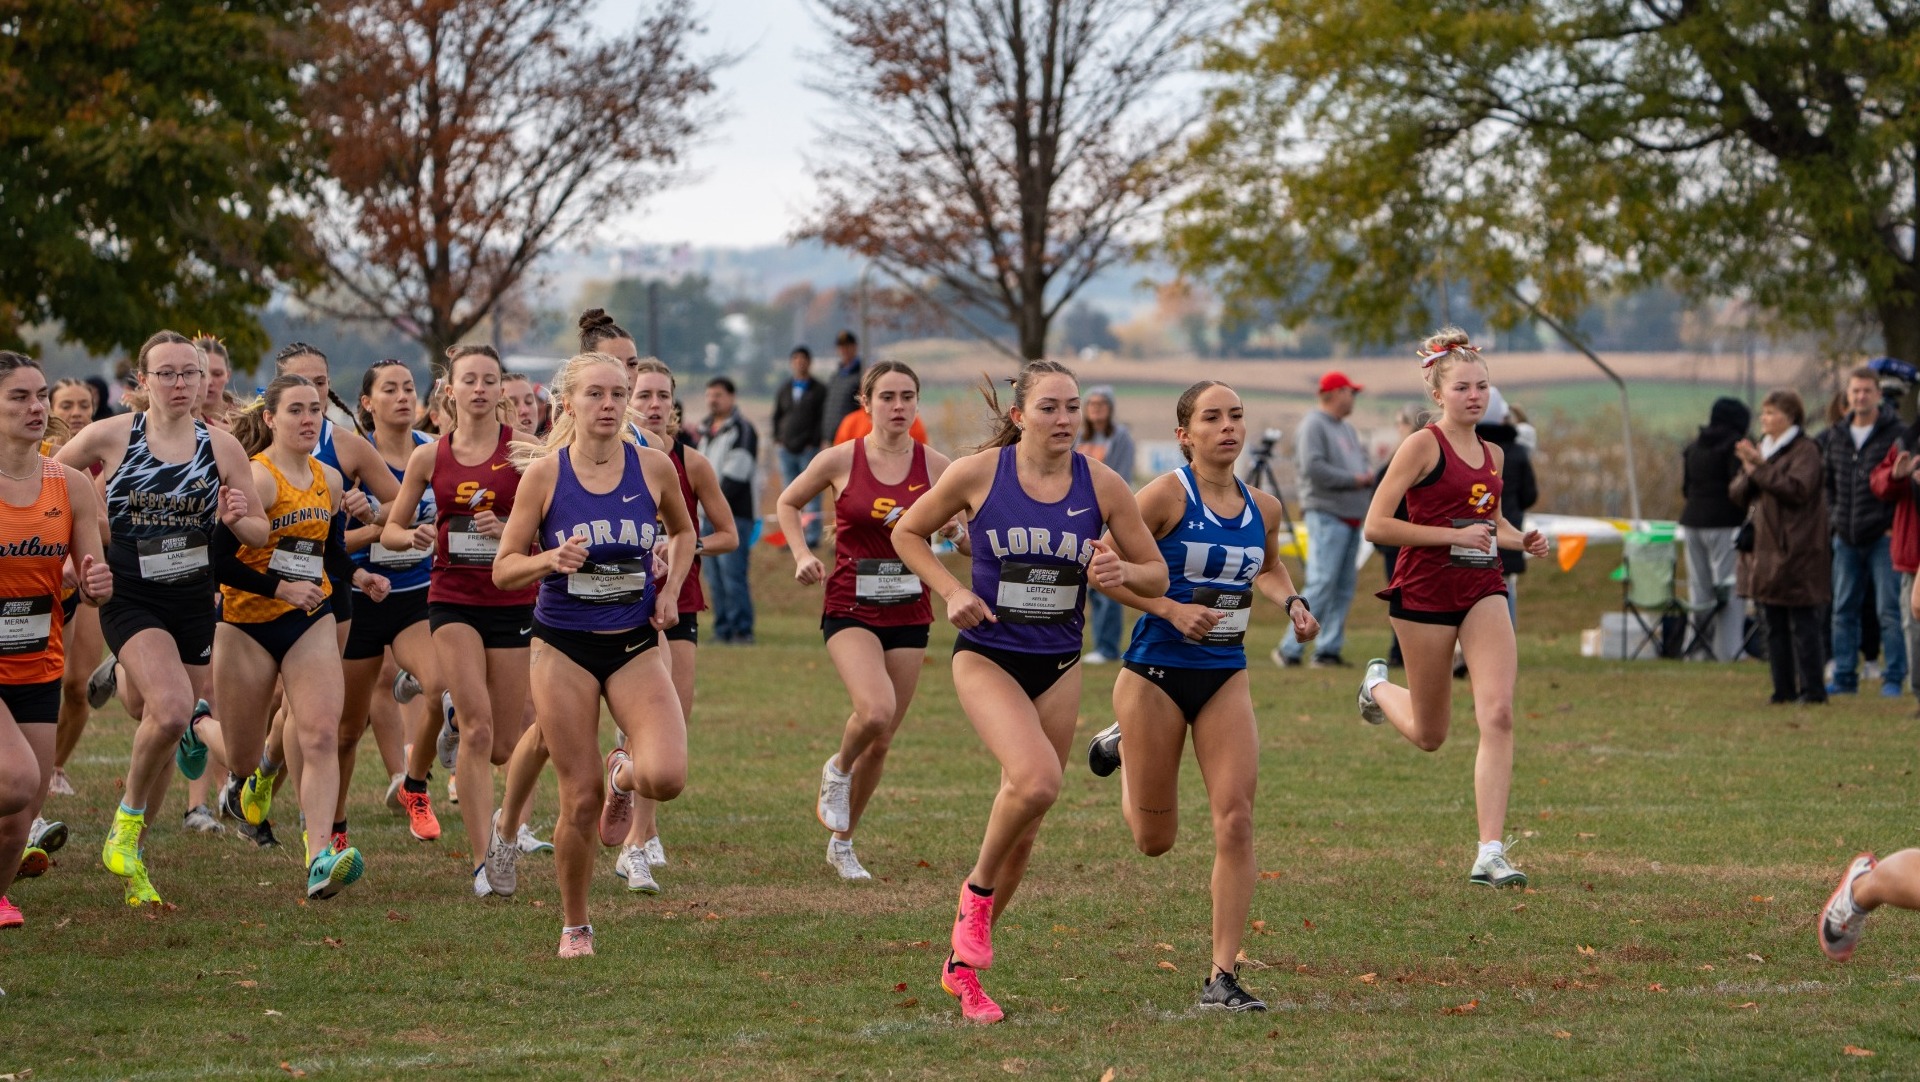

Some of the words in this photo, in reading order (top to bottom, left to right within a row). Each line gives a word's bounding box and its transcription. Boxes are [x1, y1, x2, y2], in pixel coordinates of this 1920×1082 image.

[128, 489, 206, 513] NEBRASKA
[271, 509, 313, 532] BUENA
[313, 507, 330, 522] VIS
[555, 519, 655, 550] LORAS
[986, 527, 1095, 565] LORAS
[167, 552, 185, 560] LAKE
[1026, 586, 1056, 595] LEITZEN
[4, 618, 29, 626] MERNA
